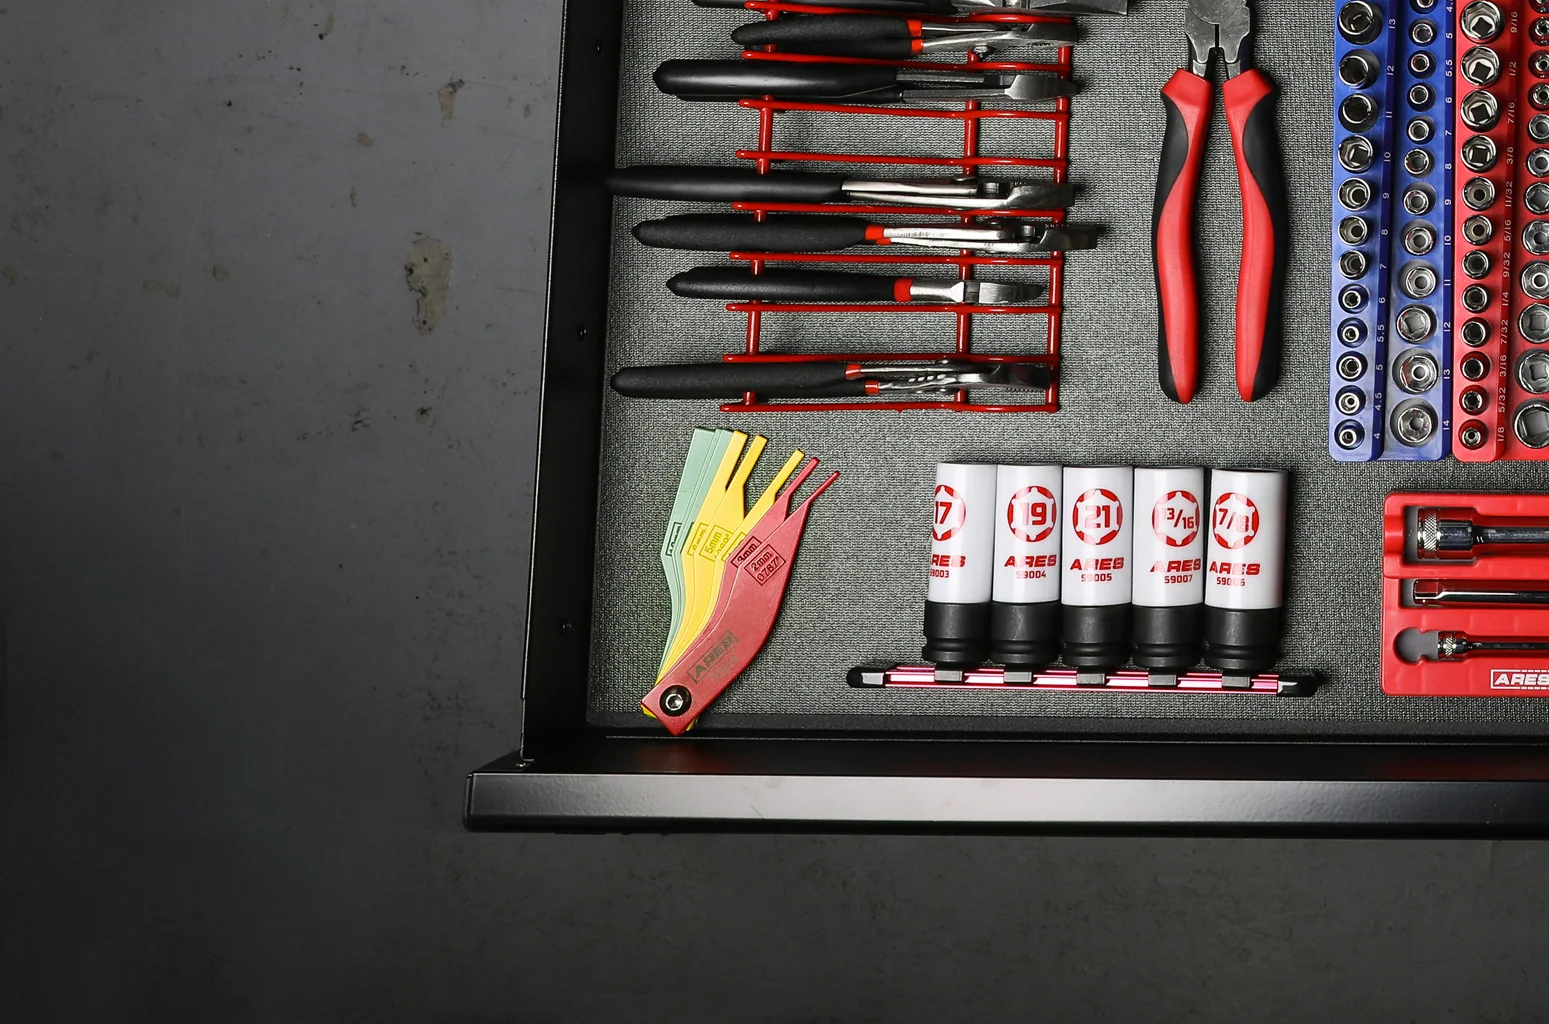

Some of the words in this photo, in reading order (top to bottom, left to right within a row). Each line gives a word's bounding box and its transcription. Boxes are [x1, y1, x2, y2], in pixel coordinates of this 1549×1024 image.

[1389, 19, 1396, 29] 13
[1387, 65, 1395, 76] 12
[1509, 61, 1517, 77] 1/2
[1386, 110, 1393, 119] 11
[1384, 152, 1391, 162] 10
[1505, 181, 1513, 208] 11/32
[1504, 220, 1512, 241] 5/16
[1444, 235, 1452, 246] 10
[1503, 253, 1511, 277] 9/32
[1444, 279, 1452, 287] 11
[1377, 324, 1385, 343] 5.5
[1444, 321, 1451, 332] 12
[1501, 320, 1509, 344] 7/32
[1500, 355, 1508, 376] 3/16
[1443, 369, 1451, 380] 13
[1374, 392, 1382, 411] 4.5
[1443, 420, 1450, 430] 14
[1019, 502, 1047, 525] 19
[1083, 504, 1110, 528] 21
[1218, 506, 1250, 532] 7/8
[705, 531, 722, 554] 5mm
[751, 551, 773, 571] 2mm
[930, 555, 966, 568] RES
[1004, 554, 1057, 568] ARES
[1069, 557, 1124, 571] ARES
[1149, 559, 1201, 573] ARES
[1016, 570, 1047, 580] 59004
[1209, 562, 1260, 576] ARES
[1080, 573, 1112, 583] 59005
[1164, 574, 1193, 585] 59007
